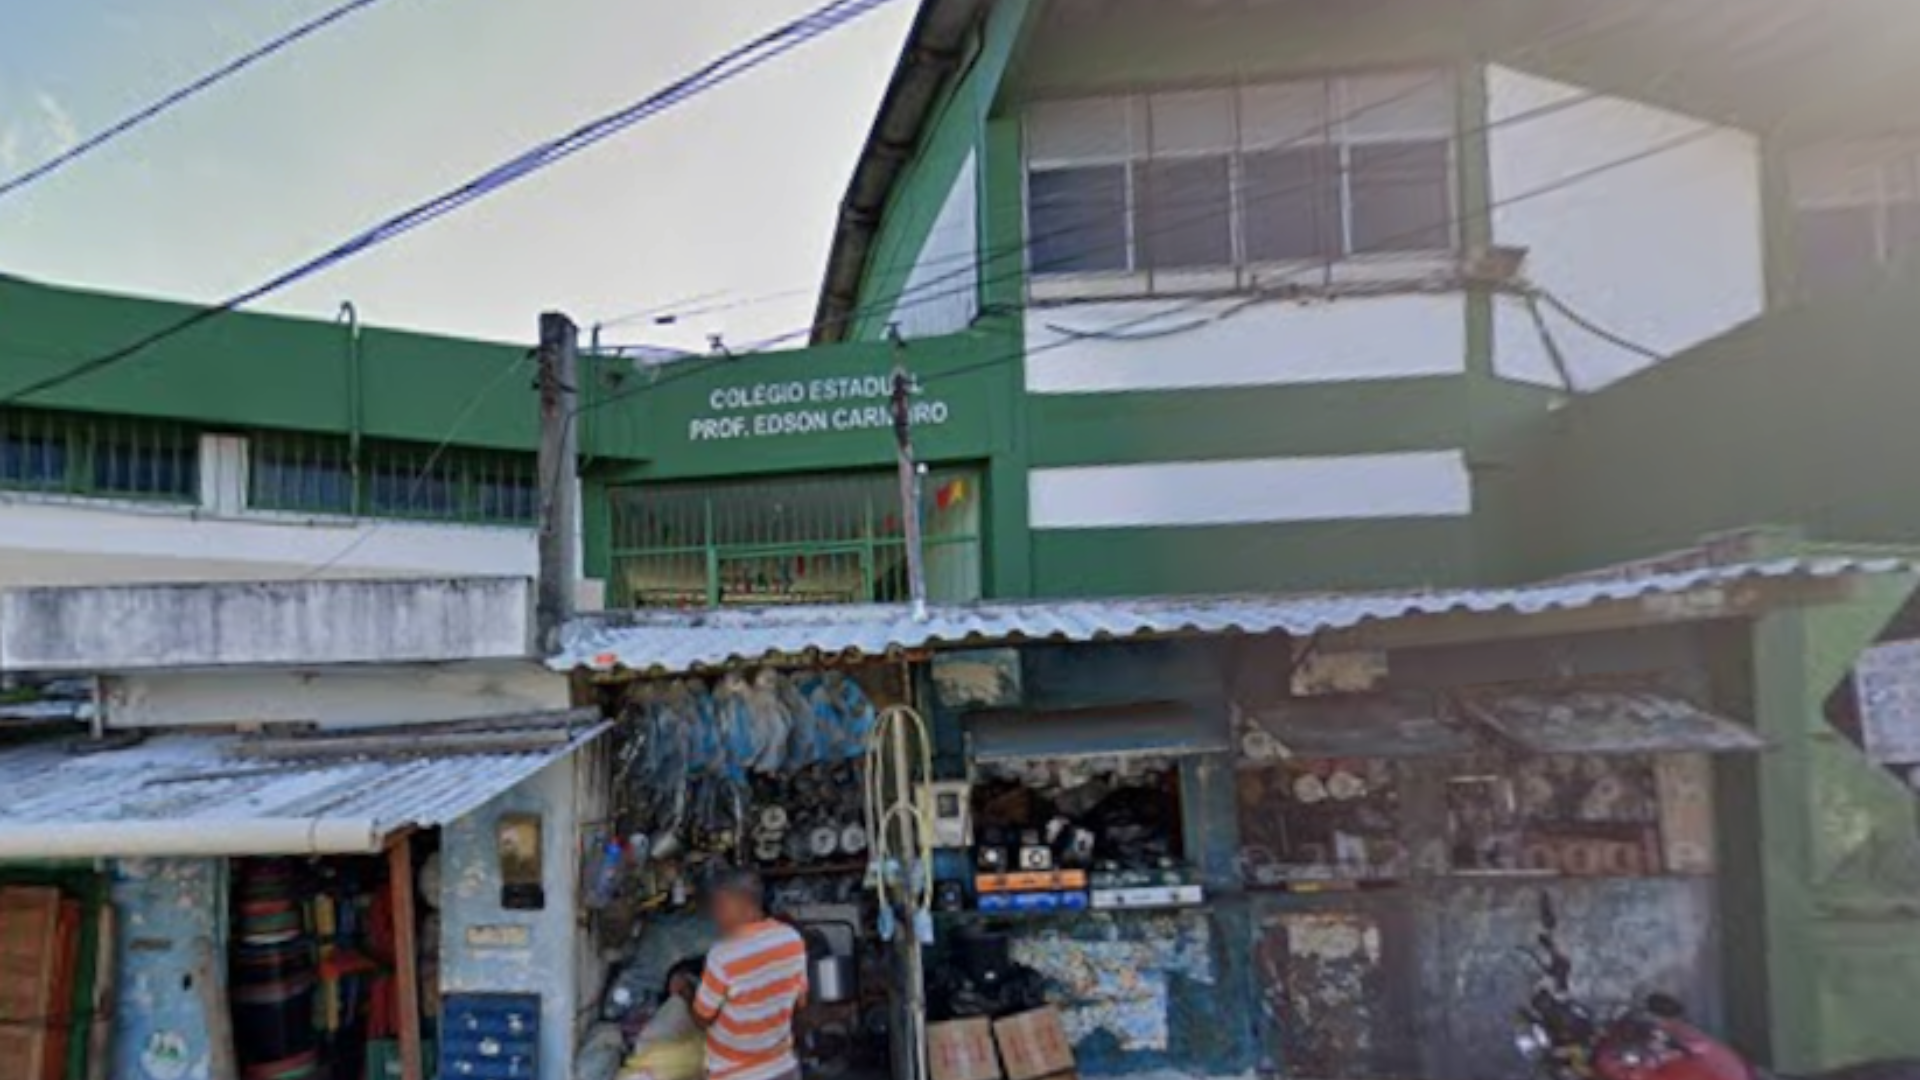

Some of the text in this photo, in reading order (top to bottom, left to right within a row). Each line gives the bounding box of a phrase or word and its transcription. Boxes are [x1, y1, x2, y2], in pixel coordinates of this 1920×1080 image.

[809, 372, 925, 401] ESTADUL
[688, 415, 750, 441] PROF.
[753, 409, 829, 436] EDSON
